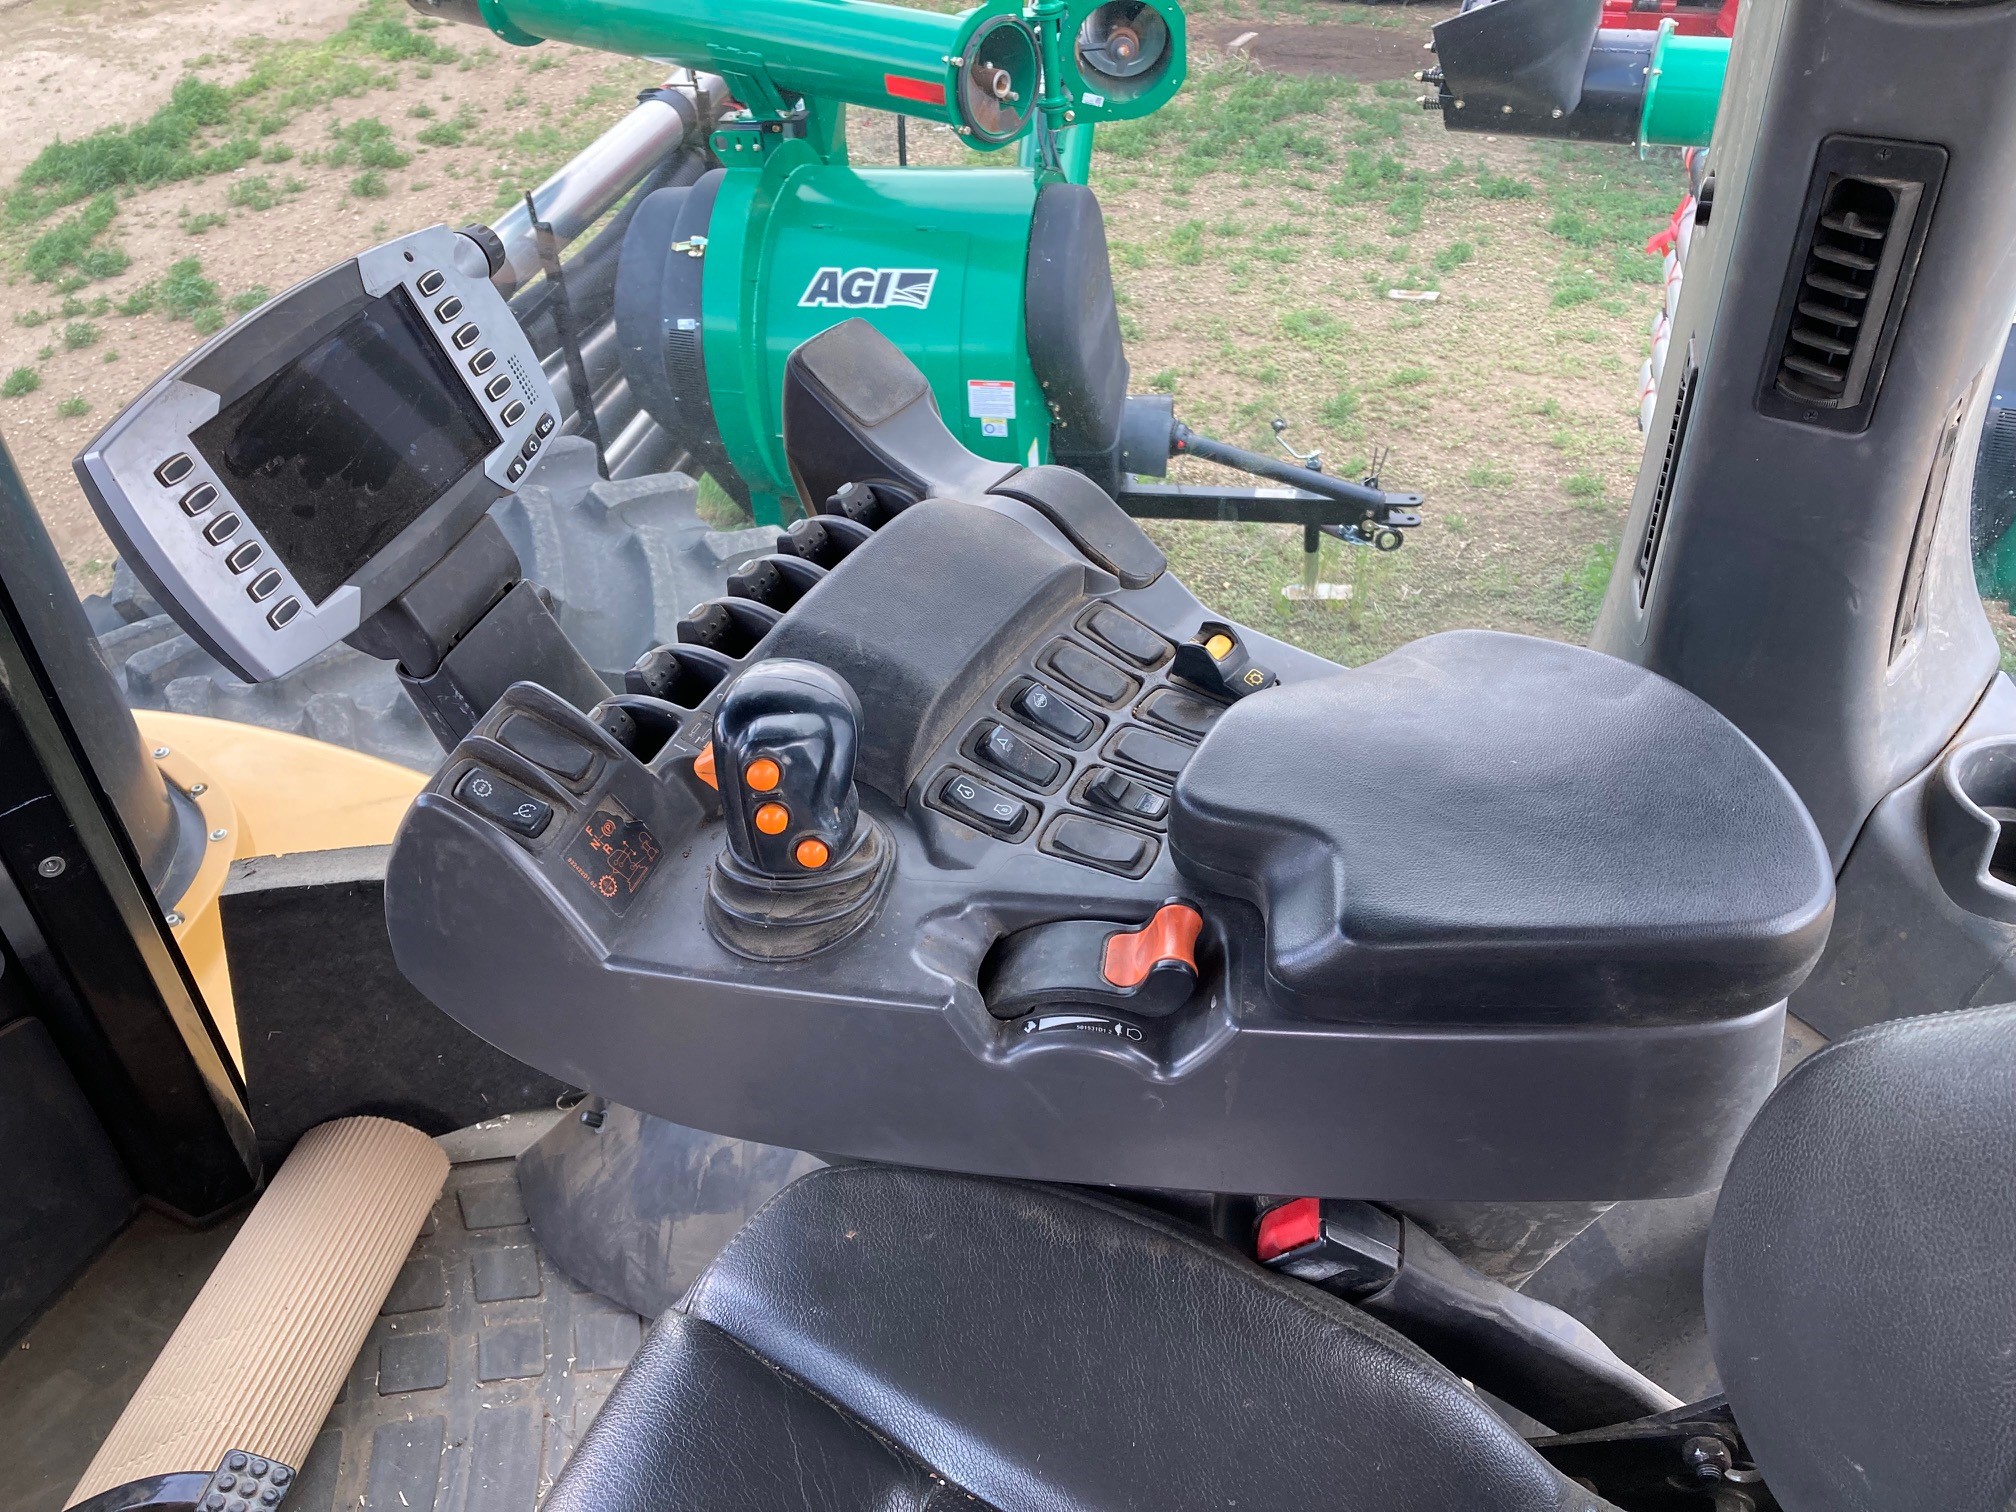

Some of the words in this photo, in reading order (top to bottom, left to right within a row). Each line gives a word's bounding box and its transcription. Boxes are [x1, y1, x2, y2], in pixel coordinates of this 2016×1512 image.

[800, 269, 894, 305] AGI
[541, 418, 553, 433] Esc
[585, 825, 593, 837] F
[590, 838, 601, 851] N
[602, 843, 614, 855] R
